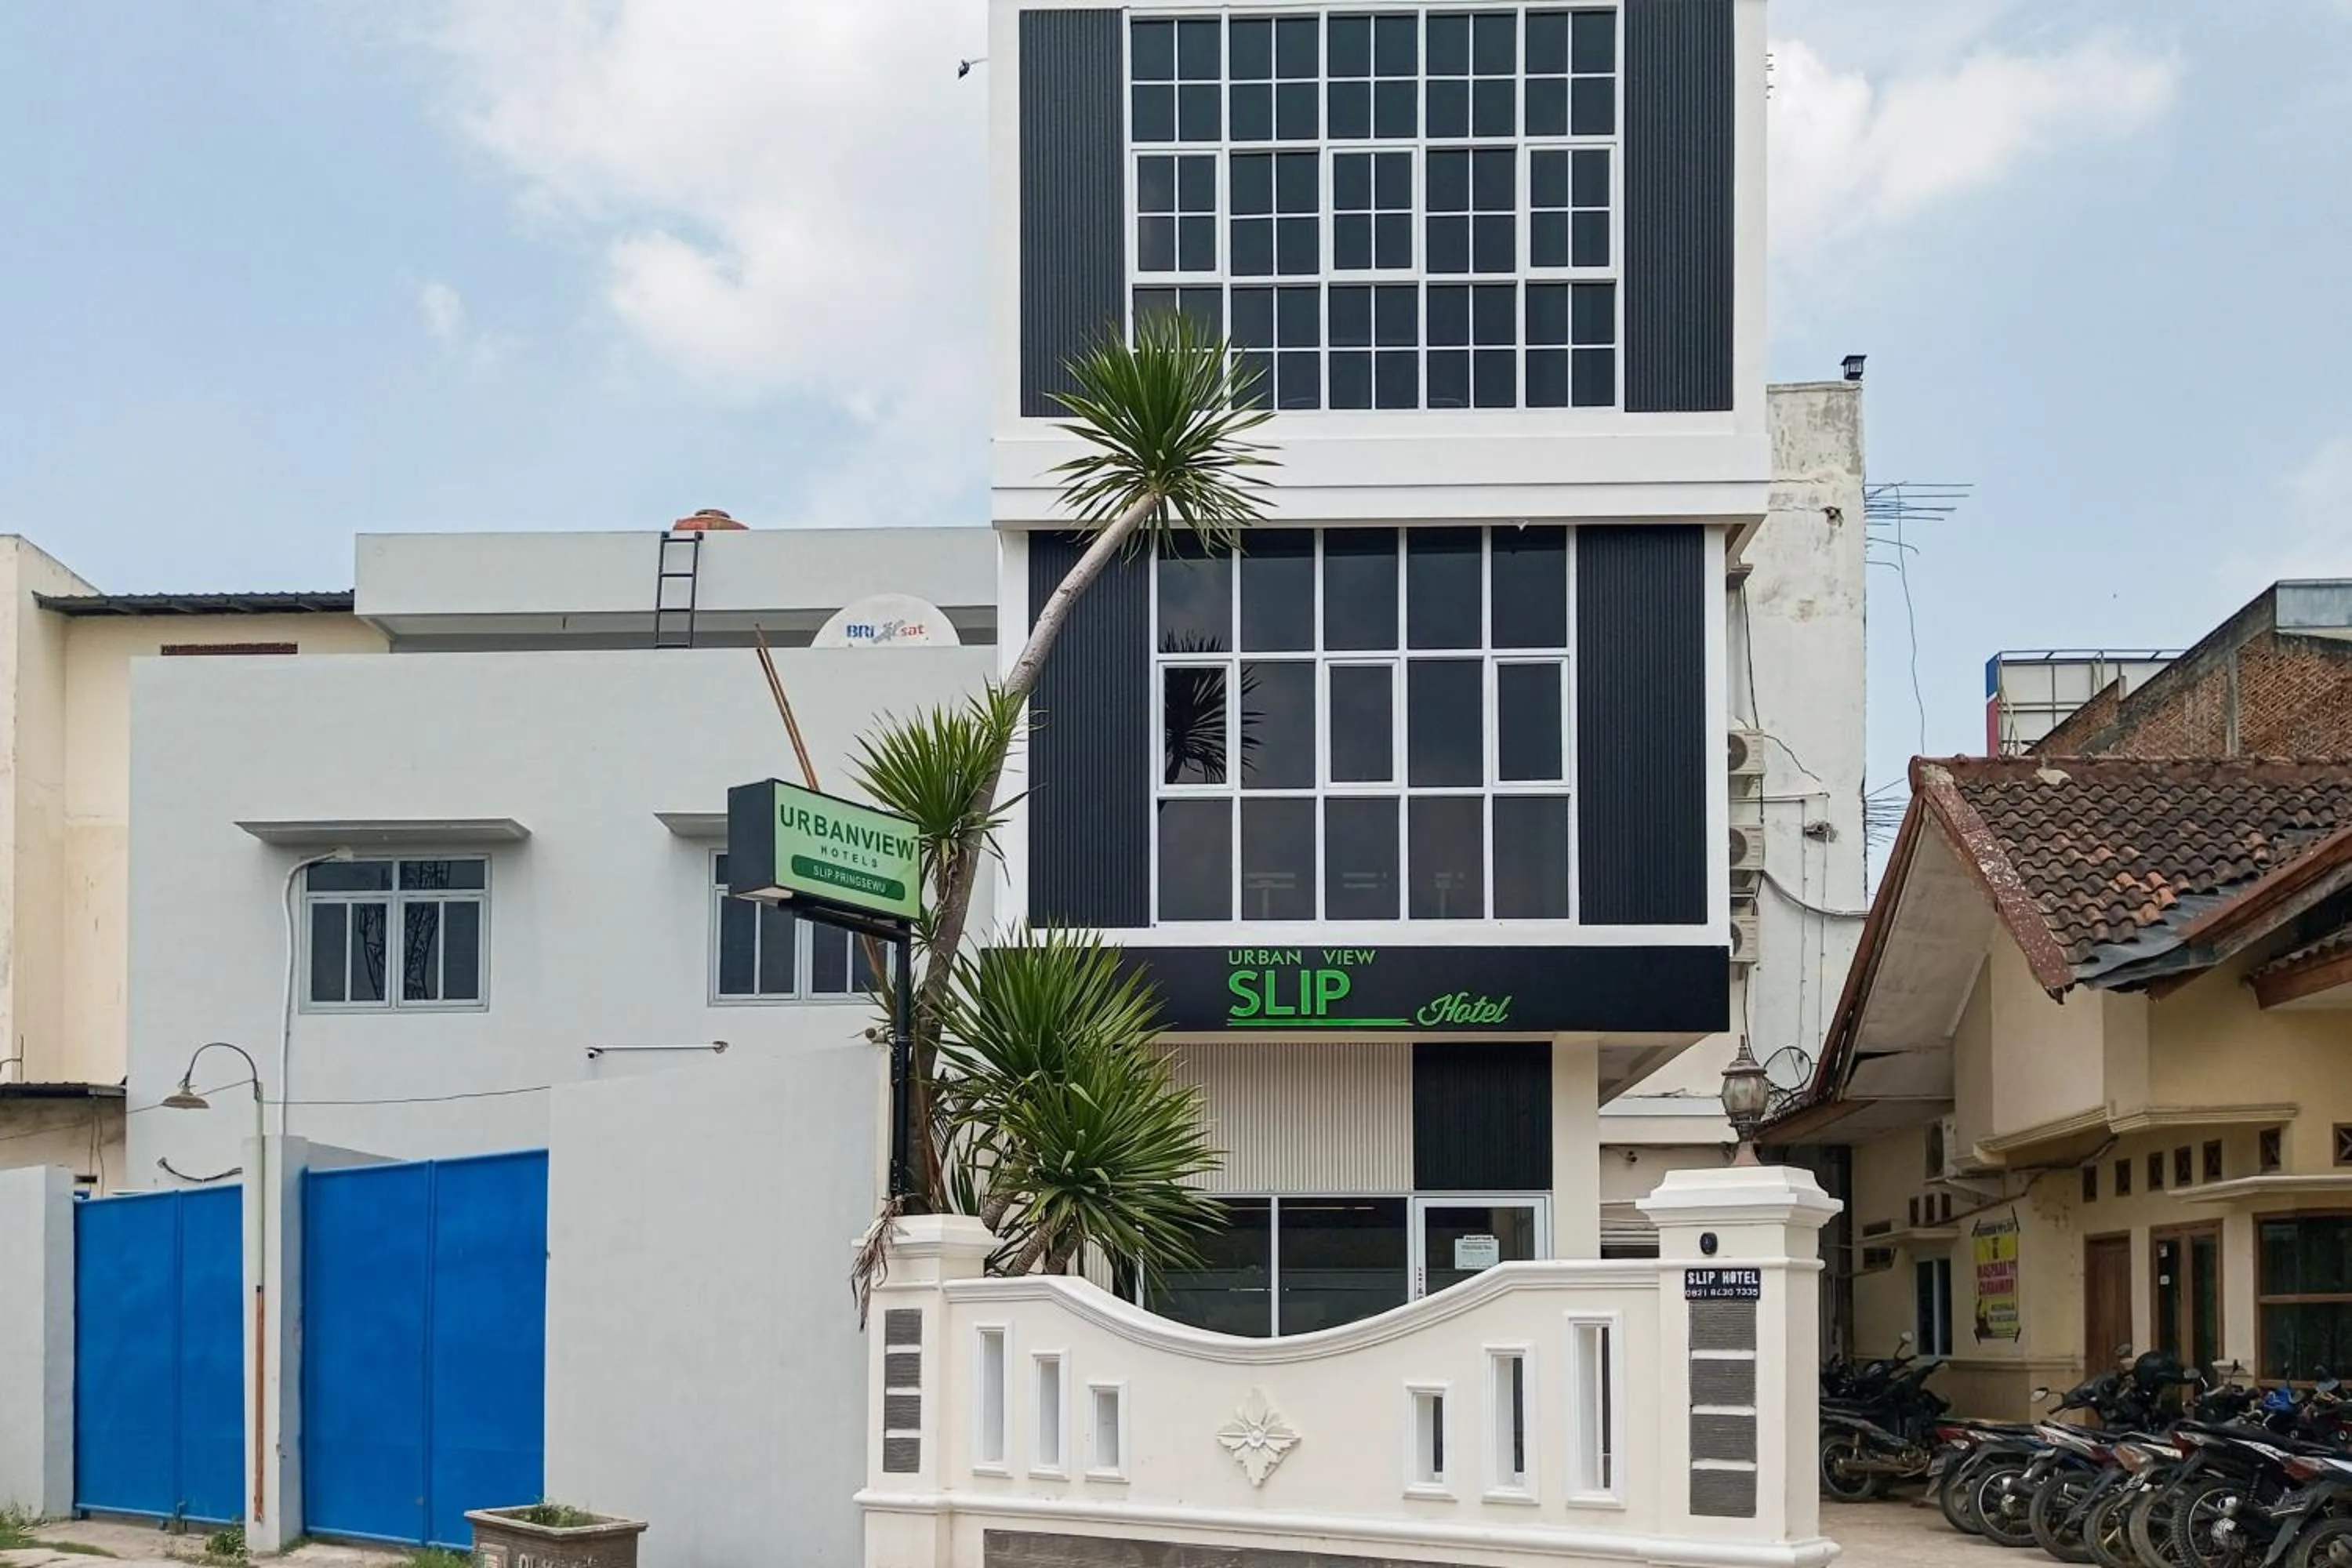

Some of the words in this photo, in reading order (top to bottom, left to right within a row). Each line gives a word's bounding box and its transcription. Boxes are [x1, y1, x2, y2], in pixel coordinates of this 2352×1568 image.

[780, 804, 914, 861] URBANVIEW
[821, 845, 878, 868] HOTELS
[813, 865, 833, 879] SLIP
[834, 871, 887, 893] PRINGSEWU
[1229, 949, 1303, 965] URBAN
[1323, 949, 1377, 965] VIEW
[1229, 970, 1351, 1017] SLIP
[1417, 992, 1512, 1026] Hotel
[1687, 1272, 1715, 1285] SLIP
[1722, 1271, 1759, 1284] HOTEL
